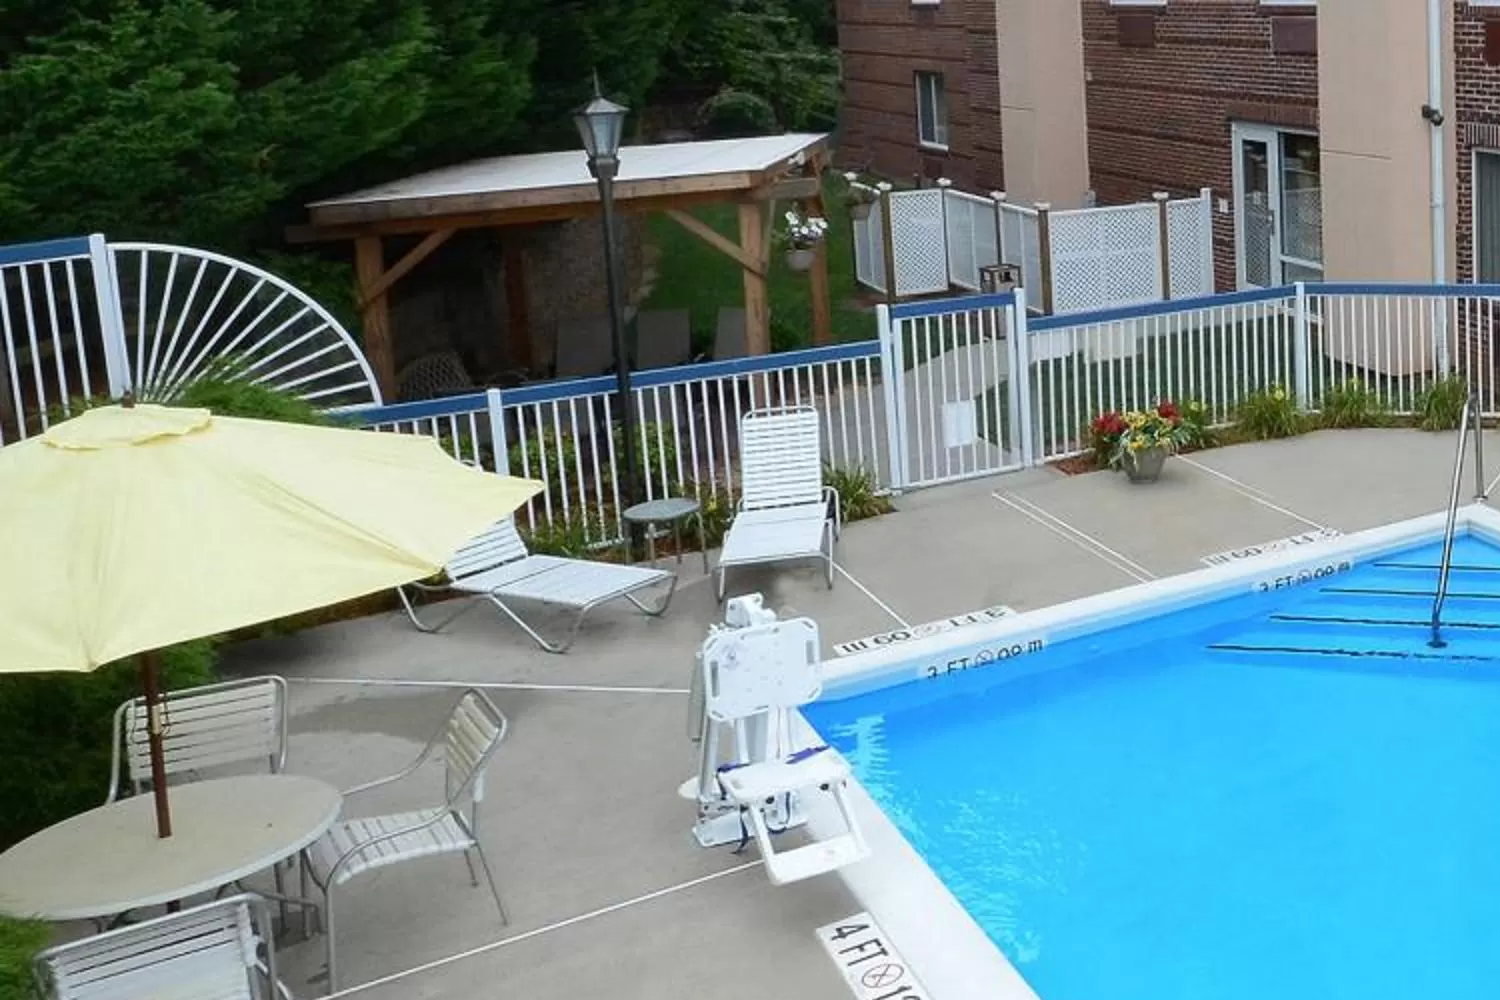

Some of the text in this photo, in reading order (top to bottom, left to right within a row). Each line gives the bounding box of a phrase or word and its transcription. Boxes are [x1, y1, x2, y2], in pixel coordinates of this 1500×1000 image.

[947, 657, 970, 677] FT
[830, 923, 870, 941] 4
[838, 938, 889, 966] FT
